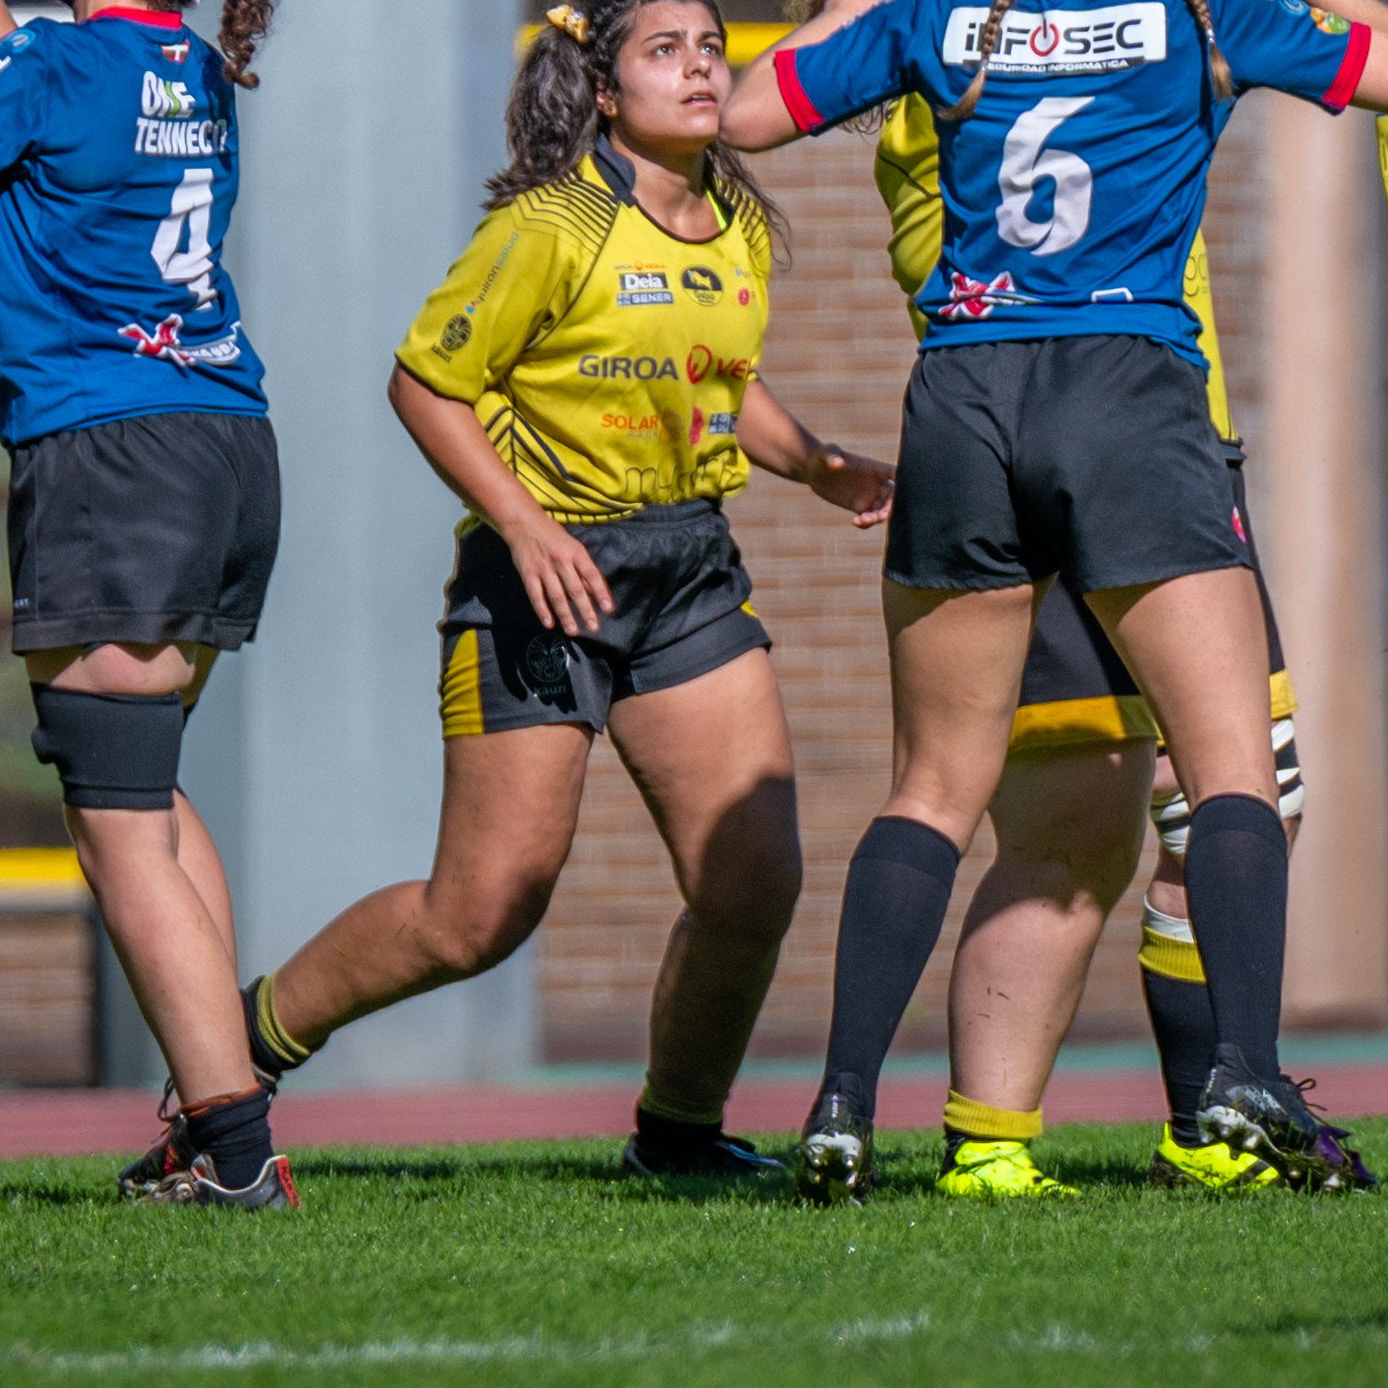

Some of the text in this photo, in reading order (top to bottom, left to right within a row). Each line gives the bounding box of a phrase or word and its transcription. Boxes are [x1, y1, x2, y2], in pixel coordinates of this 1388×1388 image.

[996, 97, 1094, 256] 6
[151, 168, 218, 311] 4
[624, 272, 664, 290] Deia
[578, 354, 679, 381] GIROA
[601, 413, 659, 430] SOLAR
